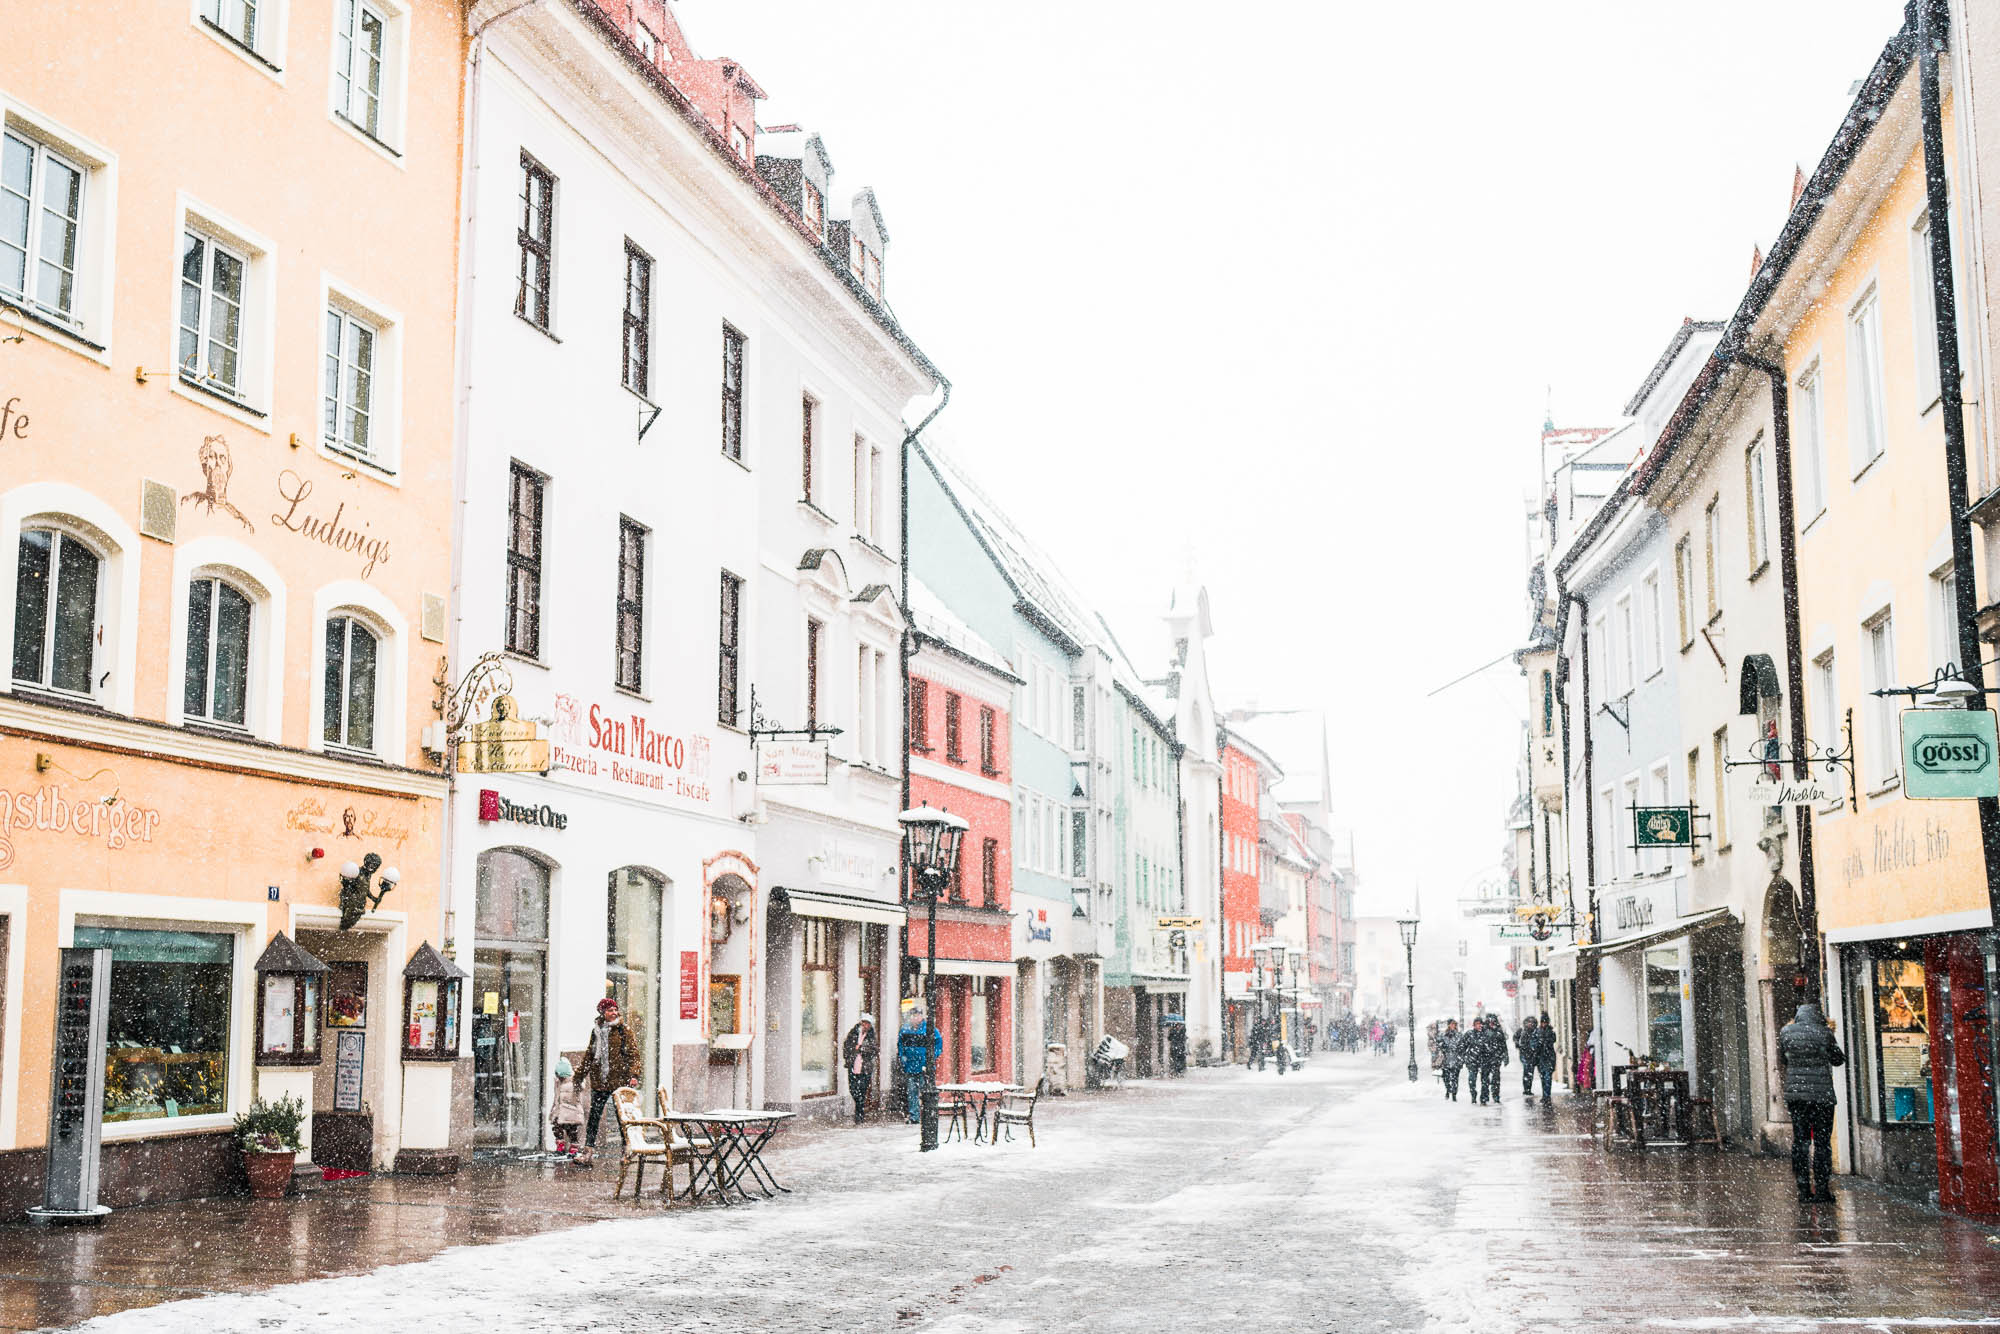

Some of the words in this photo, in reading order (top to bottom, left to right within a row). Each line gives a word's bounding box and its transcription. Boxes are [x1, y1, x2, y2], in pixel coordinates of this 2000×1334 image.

[271, 468, 391, 581] Ludwigs
[588, 703, 625, 756] San
[631, 714, 684, 770] Marco
[1922, 742, 1979, 767] gössl
[554, 746, 598, 776] Pizzeria
[612, 761, 664, 790] Restaurant
